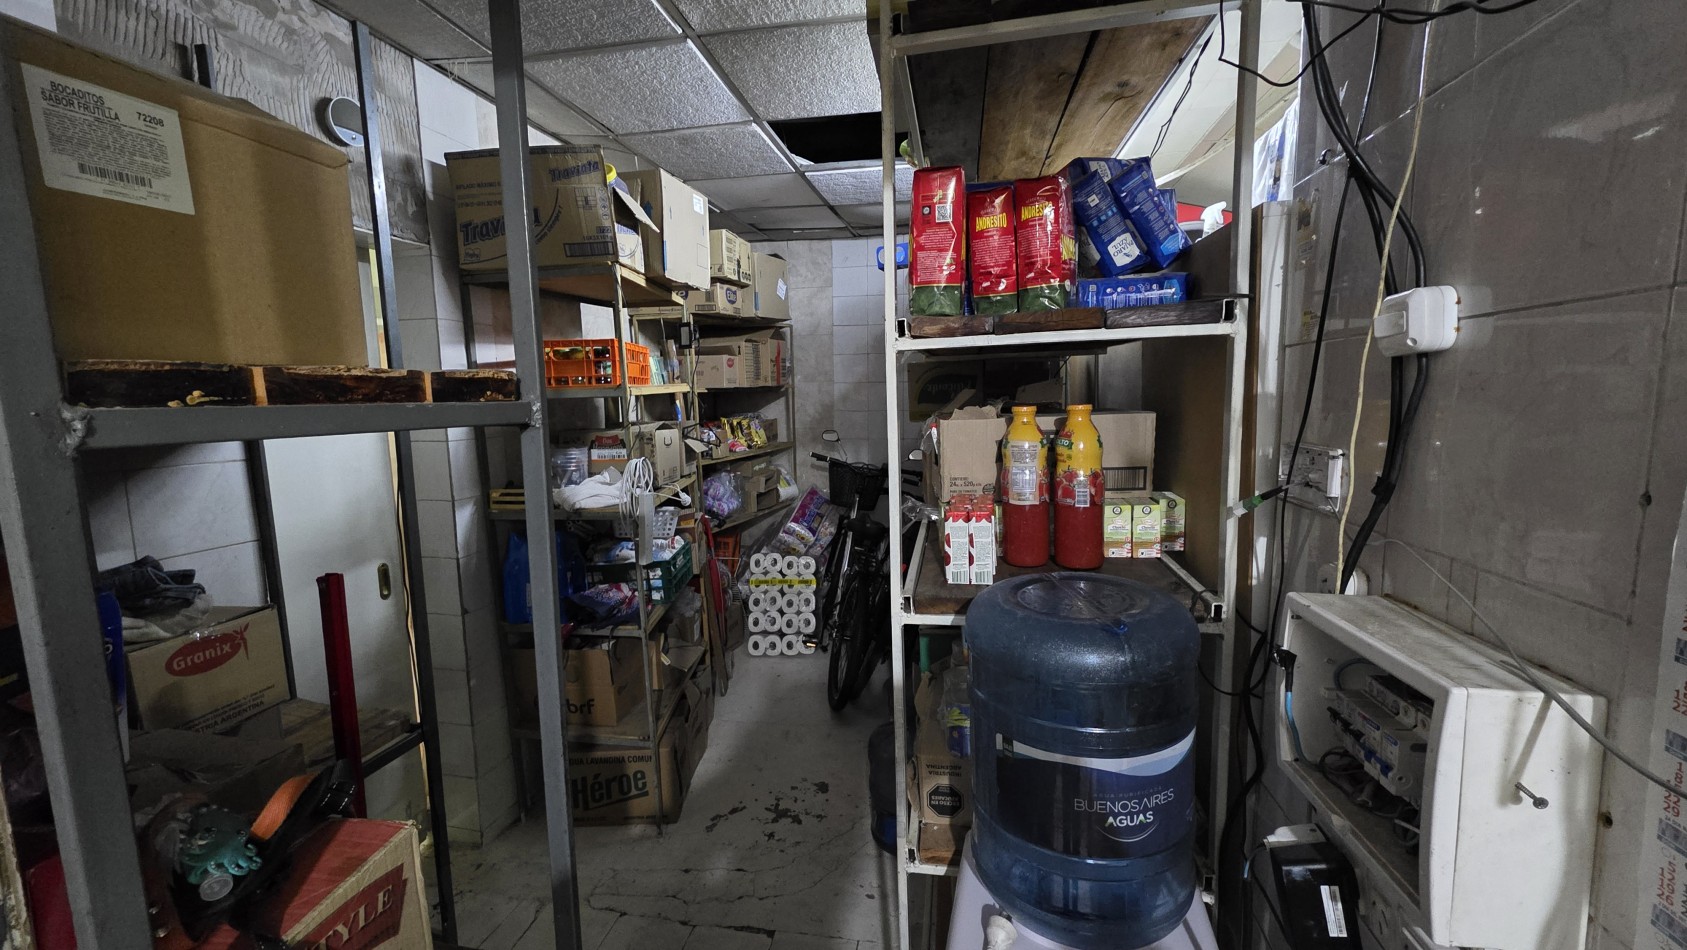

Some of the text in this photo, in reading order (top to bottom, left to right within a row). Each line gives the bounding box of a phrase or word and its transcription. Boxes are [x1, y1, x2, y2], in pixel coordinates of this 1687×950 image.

[50, 81, 105, 106] BOCADITOS
[41, 91, 121, 122] SABOR FRUTILLA
[136, 111, 164, 127] 72208
[1021, 201, 1053, 222] ANDRES
[975, 212, 1008, 232] ANDRESITO
[1112, 236, 1128, 250] AZUL
[172, 642, 233, 672] Granix
[220, 699, 265, 723] ARGENTINA
[567, 698, 595, 715] brf
[569, 756, 585, 766] GUA
[586, 755, 626, 766] LAVANDINA
[572, 769, 649, 809] Héroe
[1074, 798, 1140, 814] BUENOS
[1105, 811, 1154, 828] AGUAS
